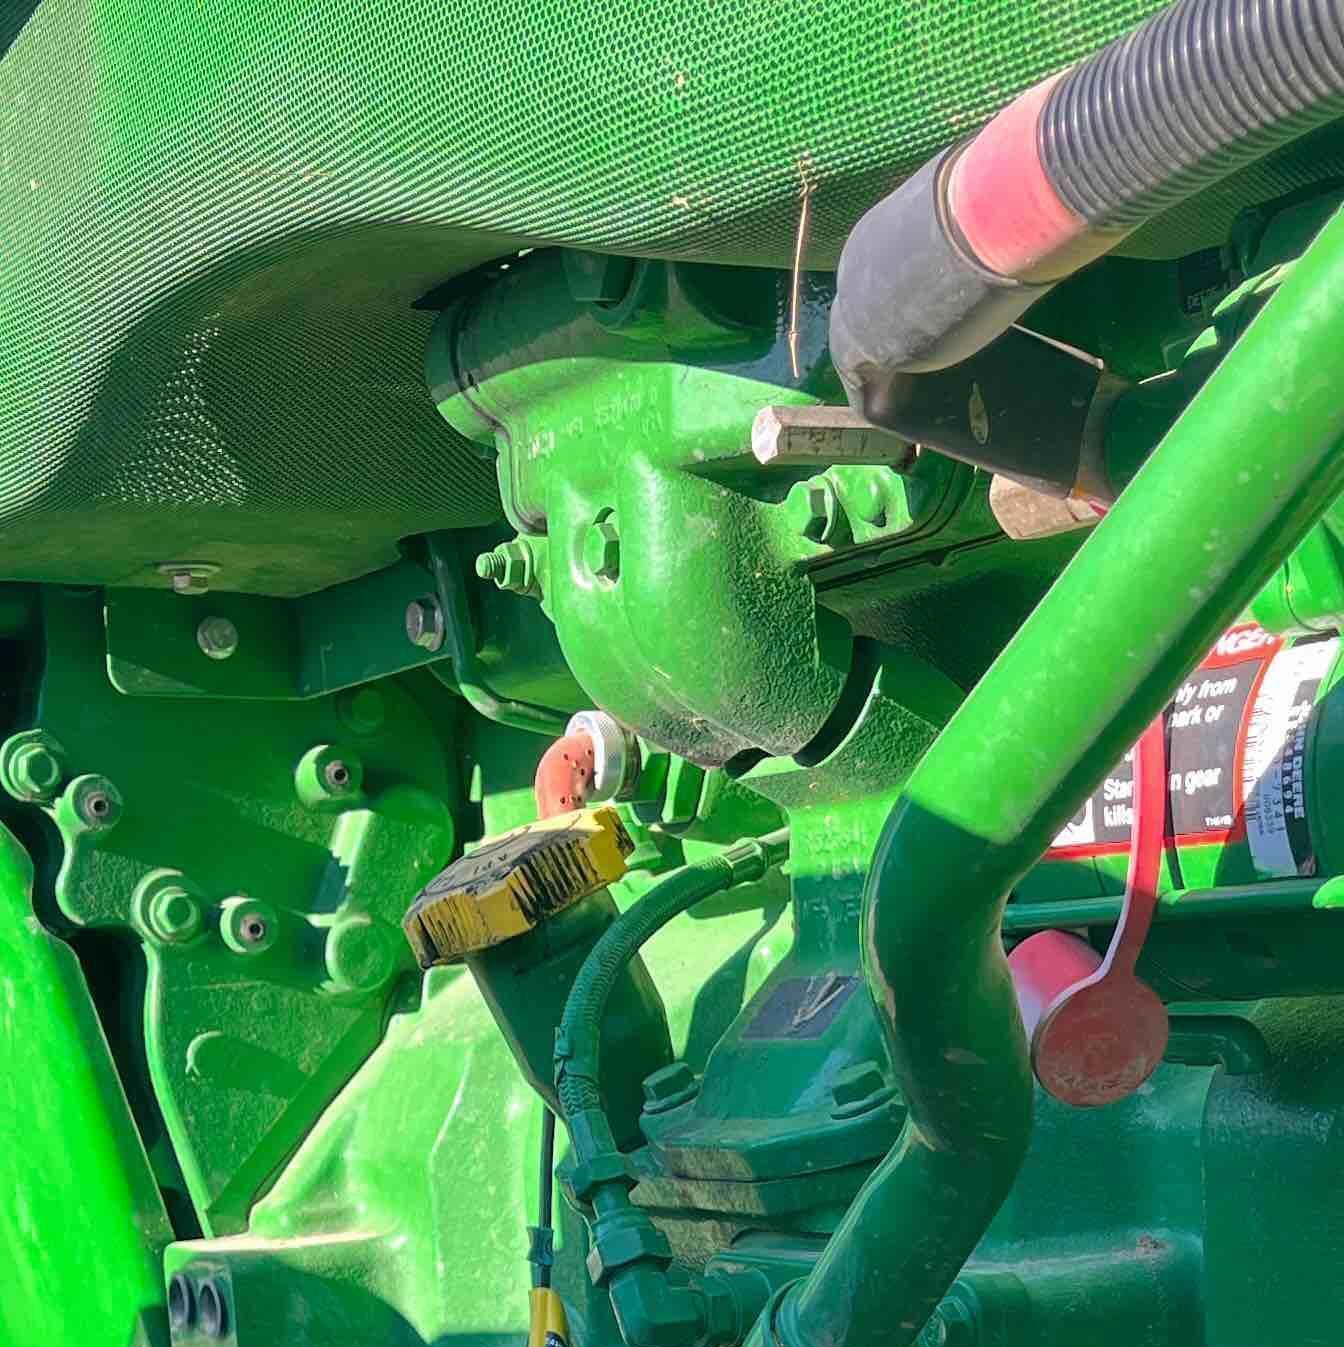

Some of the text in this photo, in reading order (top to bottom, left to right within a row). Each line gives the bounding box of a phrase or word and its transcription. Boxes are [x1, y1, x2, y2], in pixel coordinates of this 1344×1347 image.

[1197, 677, 1238, 698] from
[1204, 705, 1224, 723] or
[1184, 768, 1222, 795] gear
[1293, 756, 1305, 818] DEERE
